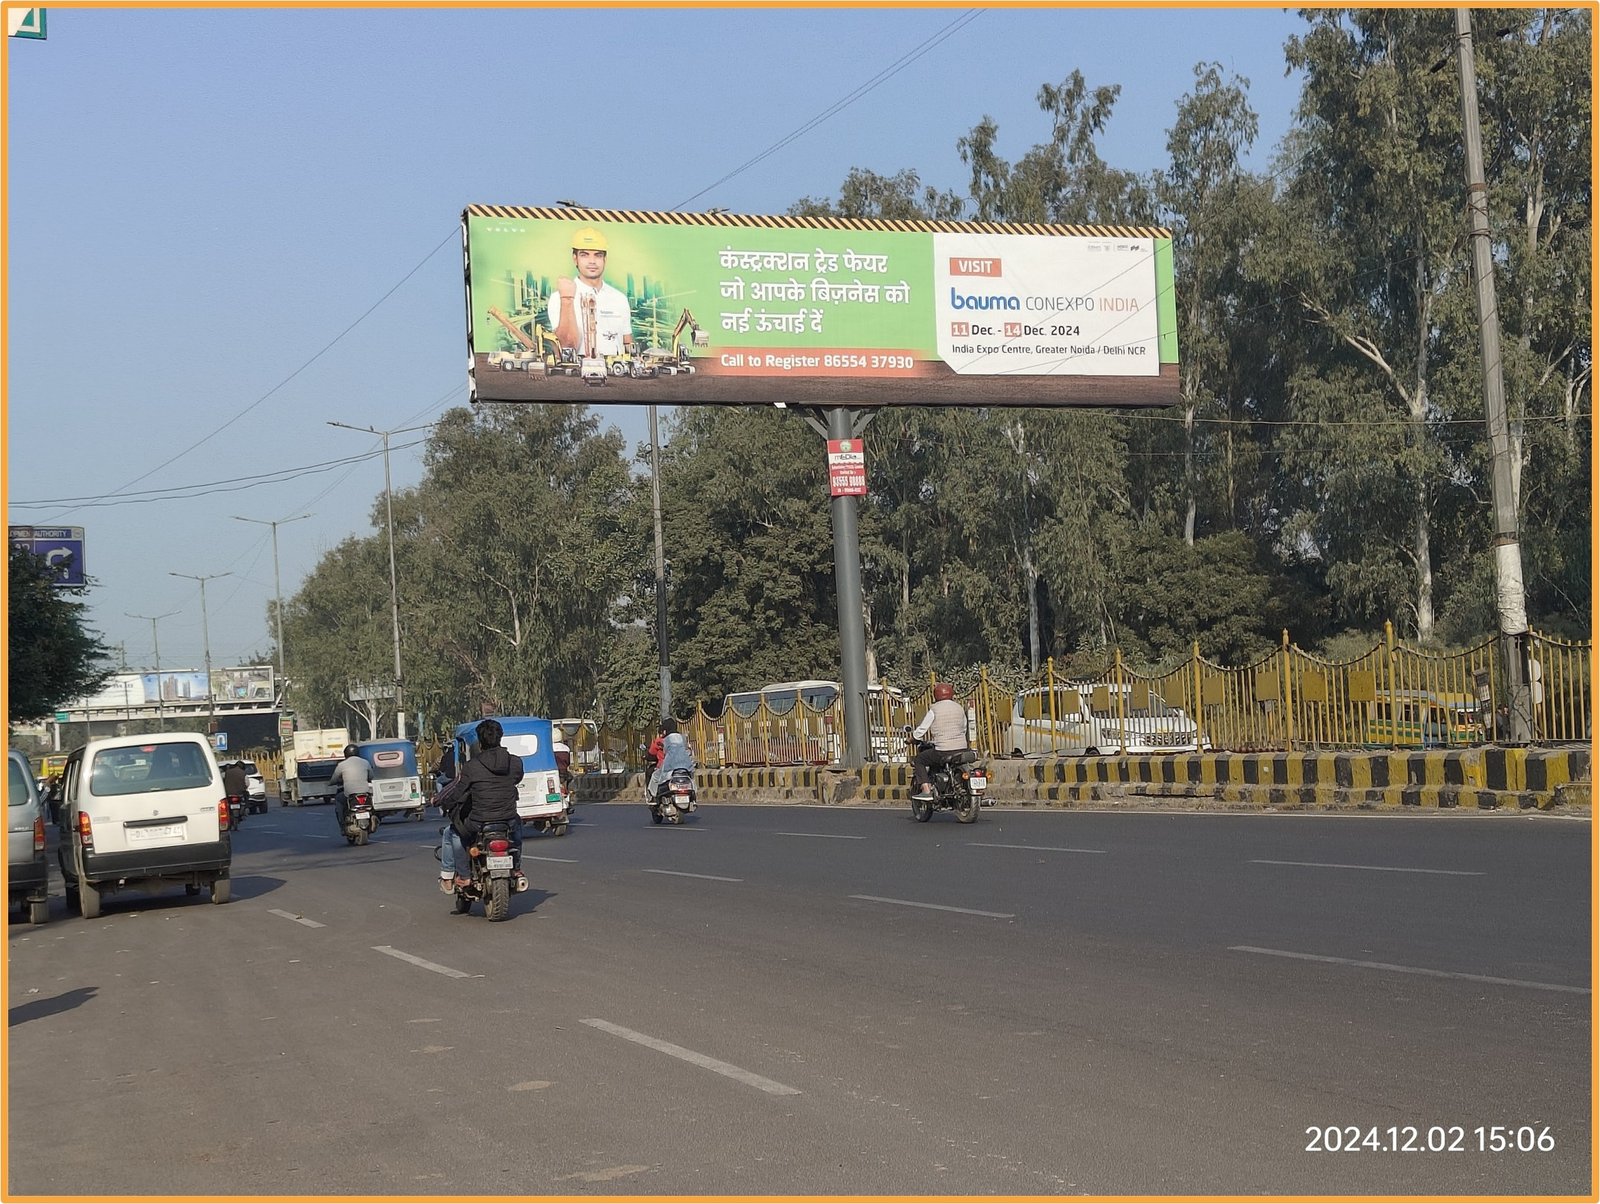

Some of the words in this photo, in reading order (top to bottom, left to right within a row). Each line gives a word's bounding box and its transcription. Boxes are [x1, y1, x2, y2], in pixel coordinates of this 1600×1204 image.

[719, 246, 810, 272] कंस्ट्रक्शन
[815, 248, 839, 273] ट्रेड
[843, 249, 888, 273] फेयर
[958, 260, 993, 274] VISIT
[720, 276, 745, 300] जो
[751, 278, 806, 302] आपके
[810, 277, 880, 304] बिज़नेस
[884, 280, 910, 304] को
[950, 287, 1020, 311] bauma
[1025, 296, 1095, 312] CONEXPO
[1100, 297, 1139, 312] INDIA
[720, 308, 752, 333] नई
[755, 308, 806, 334] ऊंचाई
[809, 309, 824, 333] दें
[952, 324, 968, 336] 11
[1005, 324, 1021, 336] 14
[1051, 325, 1080, 336] 2024
[952, 344, 974, 354] India
[977, 345, 999, 356] Expo
[1001, 345, 1033, 355] Centre,
[1035, 345, 1069, 355] Greater
[1070, 345, 1096, 355] Noida
[1103, 345, 1126, 355] Delhi
[1128, 346, 1146, 356] NCR
[721, 354, 744, 367] Call
[748, 355, 761, 367] to
[766, 354, 820, 370] Register
[824, 355, 867, 368] 86554
[871, 356, 914, 369] 37930
[34, 530, 68, 538] AUTHORITY
